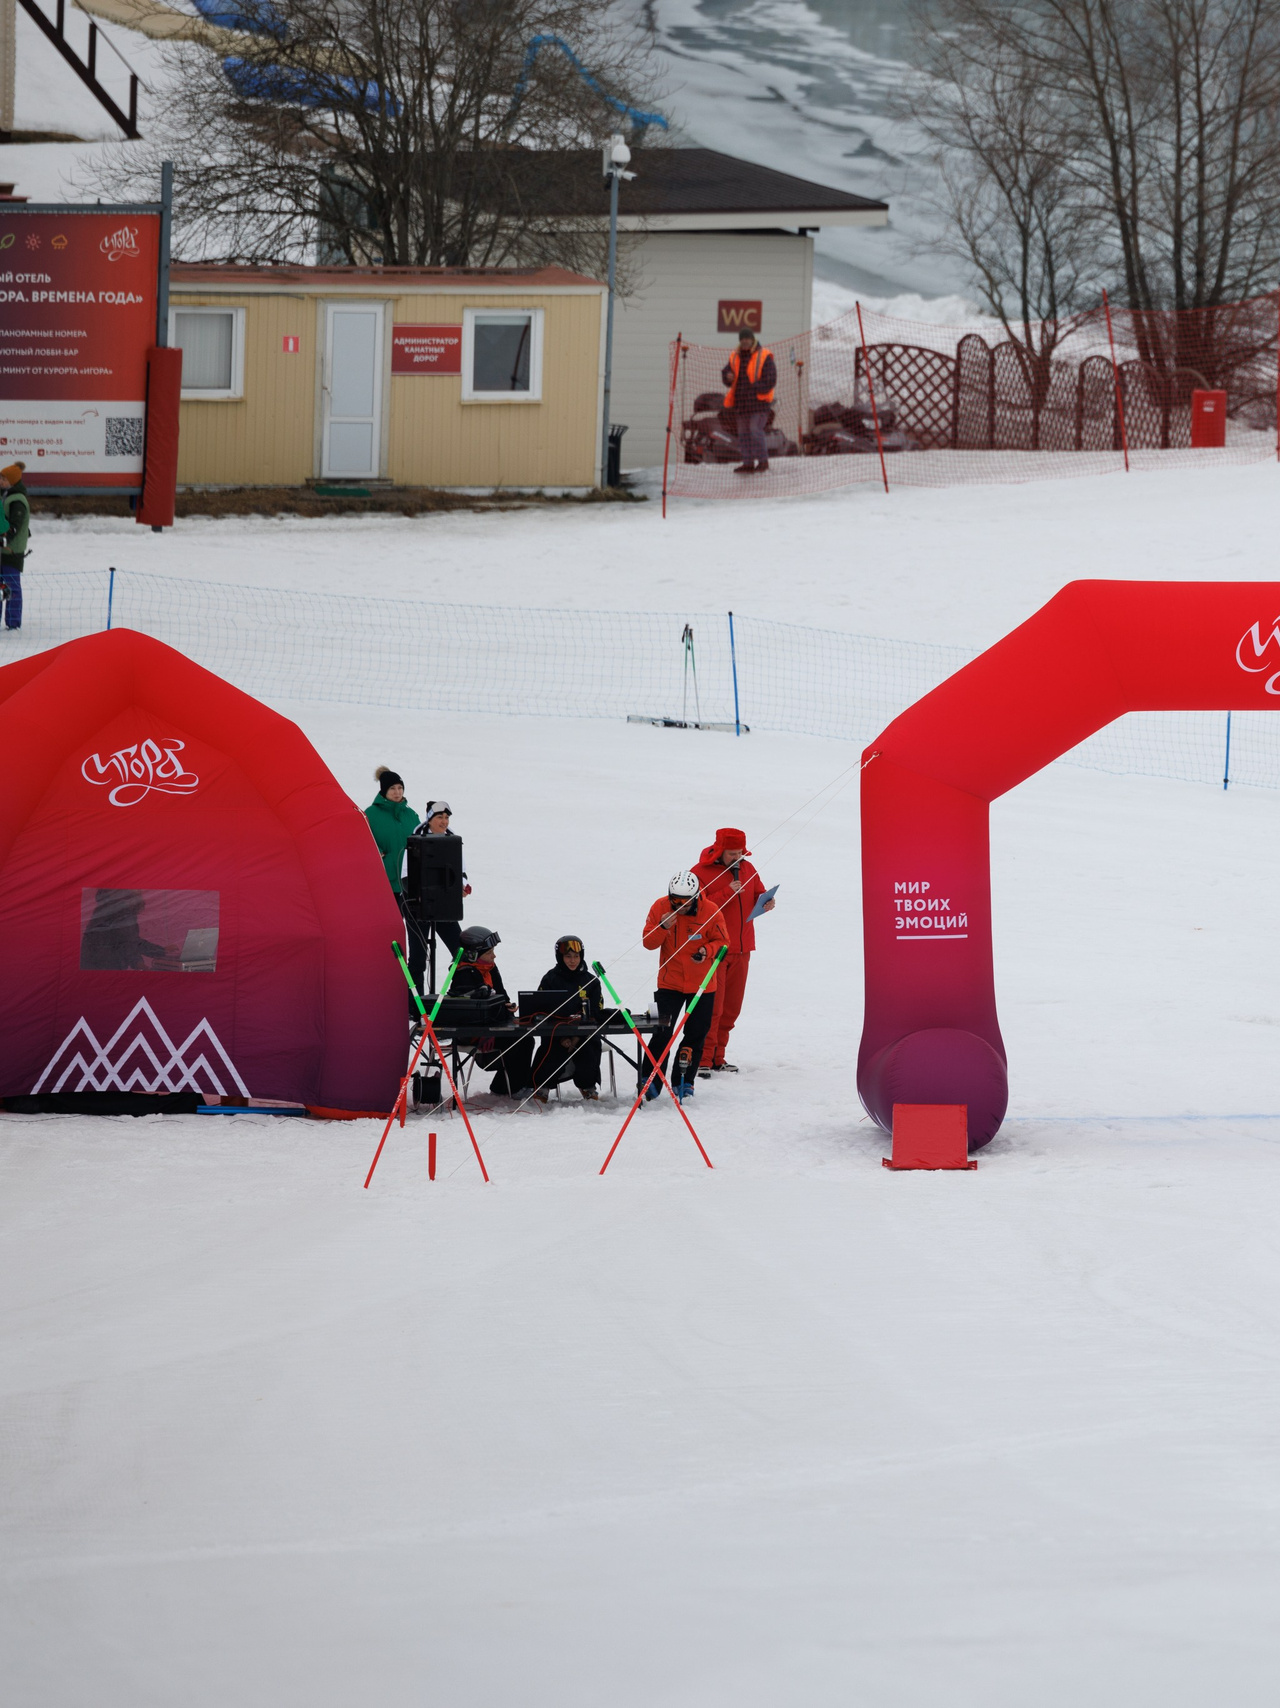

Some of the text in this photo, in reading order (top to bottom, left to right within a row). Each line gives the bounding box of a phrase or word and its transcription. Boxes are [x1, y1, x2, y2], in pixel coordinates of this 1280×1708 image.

[15, 273, 51, 283] ОТЕЛЬ
[0, 291, 143, 305] ОРА. ВРЕМЕНА ГОДА»
[721, 308, 757, 326] WC
[0, 330, 88, 338] ПАНОРАМНЫЕ НОМЕРА
[394, 337, 459, 345] АДМИНИСТРАТОР
[35, 348, 79, 356] ЛОББИ-БАР
[413, 355, 439, 363] ДОРОГ
[3, 366, 31, 374] МИНУТ
[32, 366, 42, 374] ОТ
[44, 367, 79, 375] КУРОРТА
[80, 367, 113, 375] «ИГОРА»
[894, 881, 930, 894] МИР
[894, 898, 951, 912] ТВОИХ
[895, 912, 968, 930] ЭМОЦИЙ
